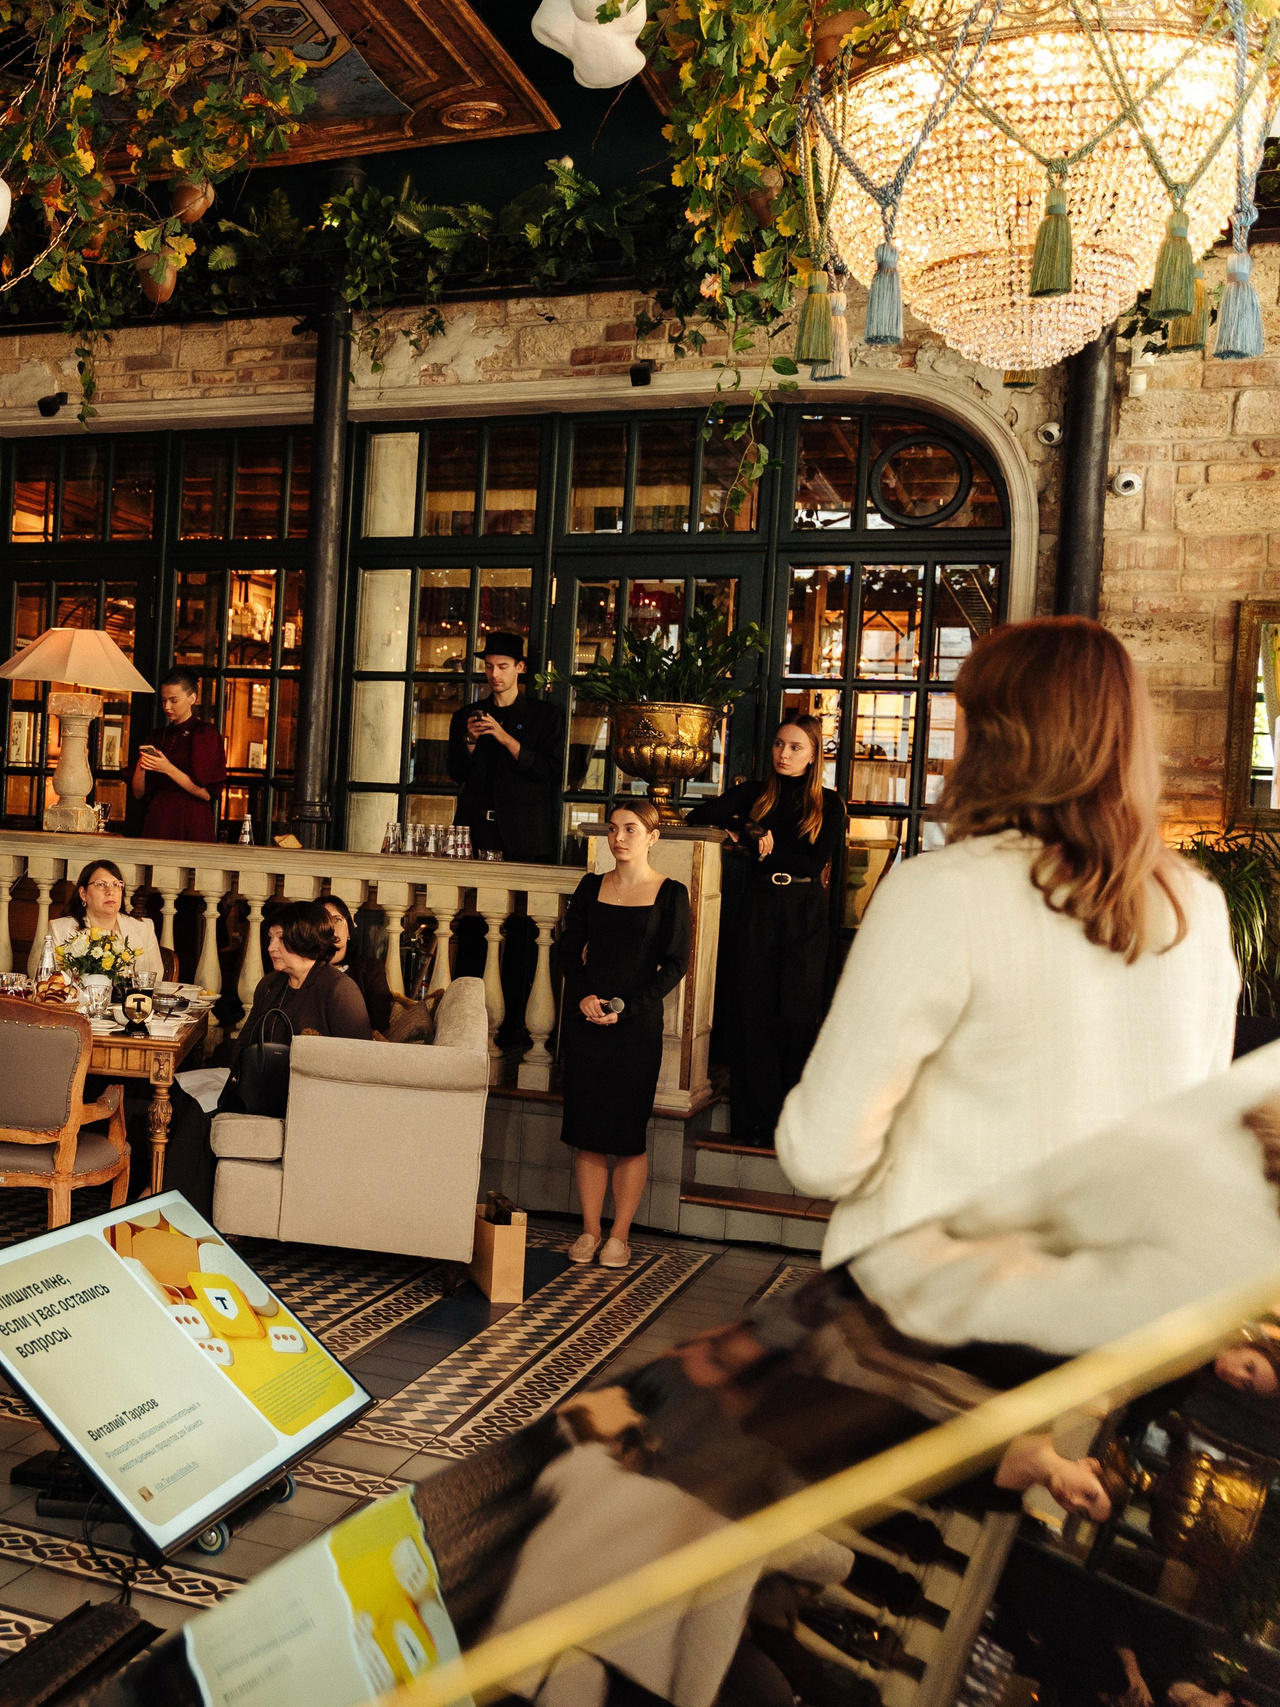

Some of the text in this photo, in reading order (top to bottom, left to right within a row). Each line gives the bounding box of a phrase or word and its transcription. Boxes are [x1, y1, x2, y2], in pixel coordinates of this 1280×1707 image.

[40, 1273, 72, 1292] мне,
[27, 1311, 41, 1327] у
[36, 1302, 61, 1321] вас
[58, 1283, 111, 1312] остались
[15, 1326, 73, 1358] вопросы
[87, 1398, 159, 1441] Виталий Тарасов
